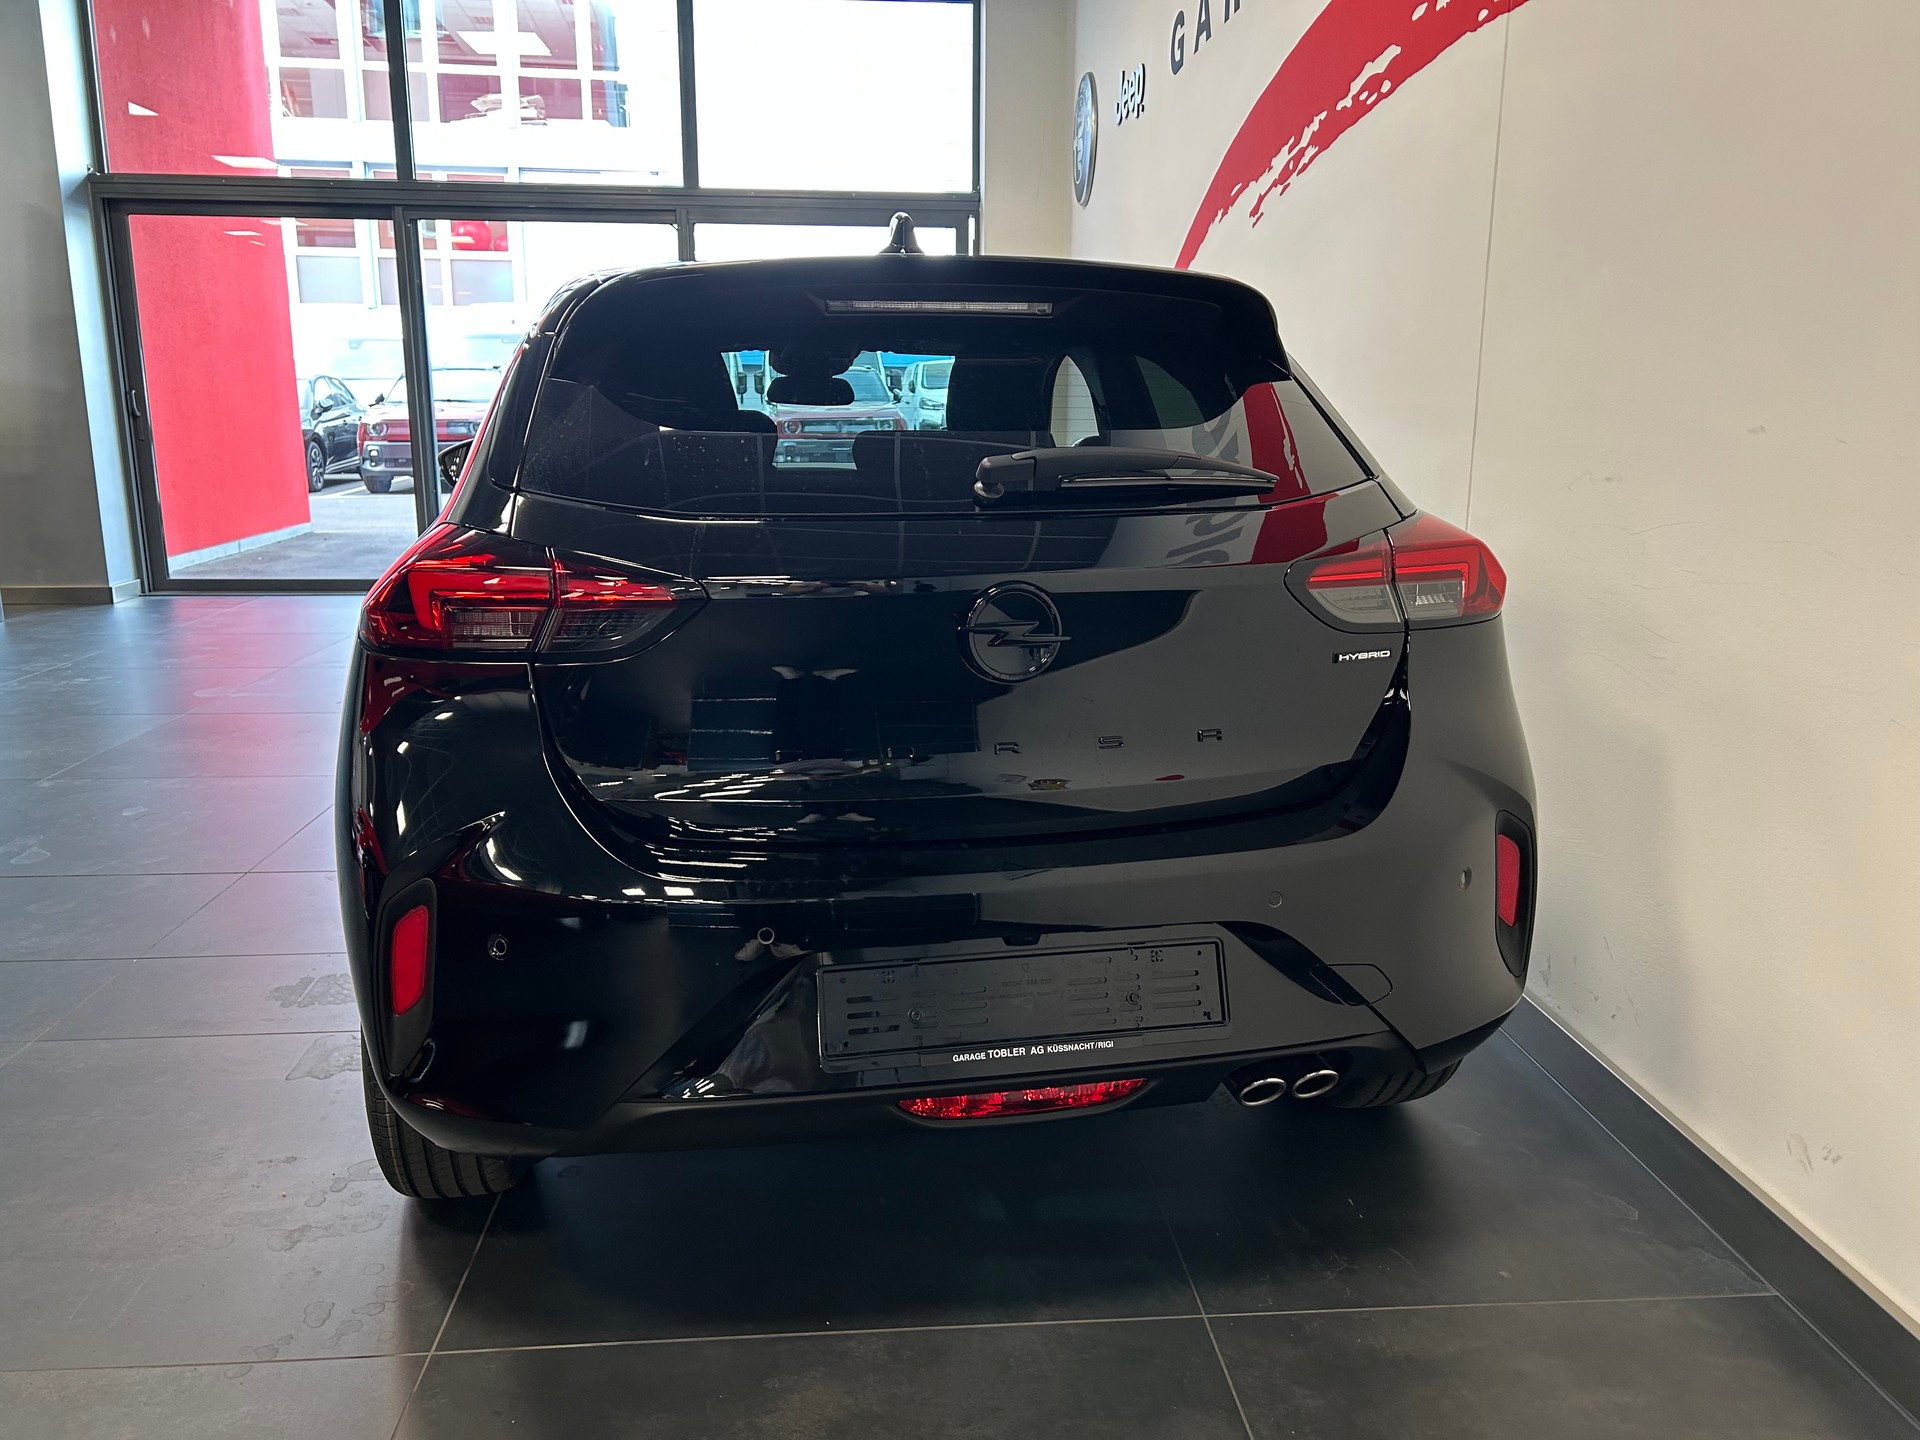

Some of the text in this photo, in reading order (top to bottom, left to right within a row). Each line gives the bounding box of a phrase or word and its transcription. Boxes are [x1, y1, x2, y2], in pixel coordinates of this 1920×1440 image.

[1114, 62, 1145, 126] Jeep
[1338, 650, 1391, 662] HYBRID
[952, 1052, 986, 1062] GARAGE
[987, 1047, 1026, 1059] TOBLER
[1030, 1045, 1045, 1056] AG
